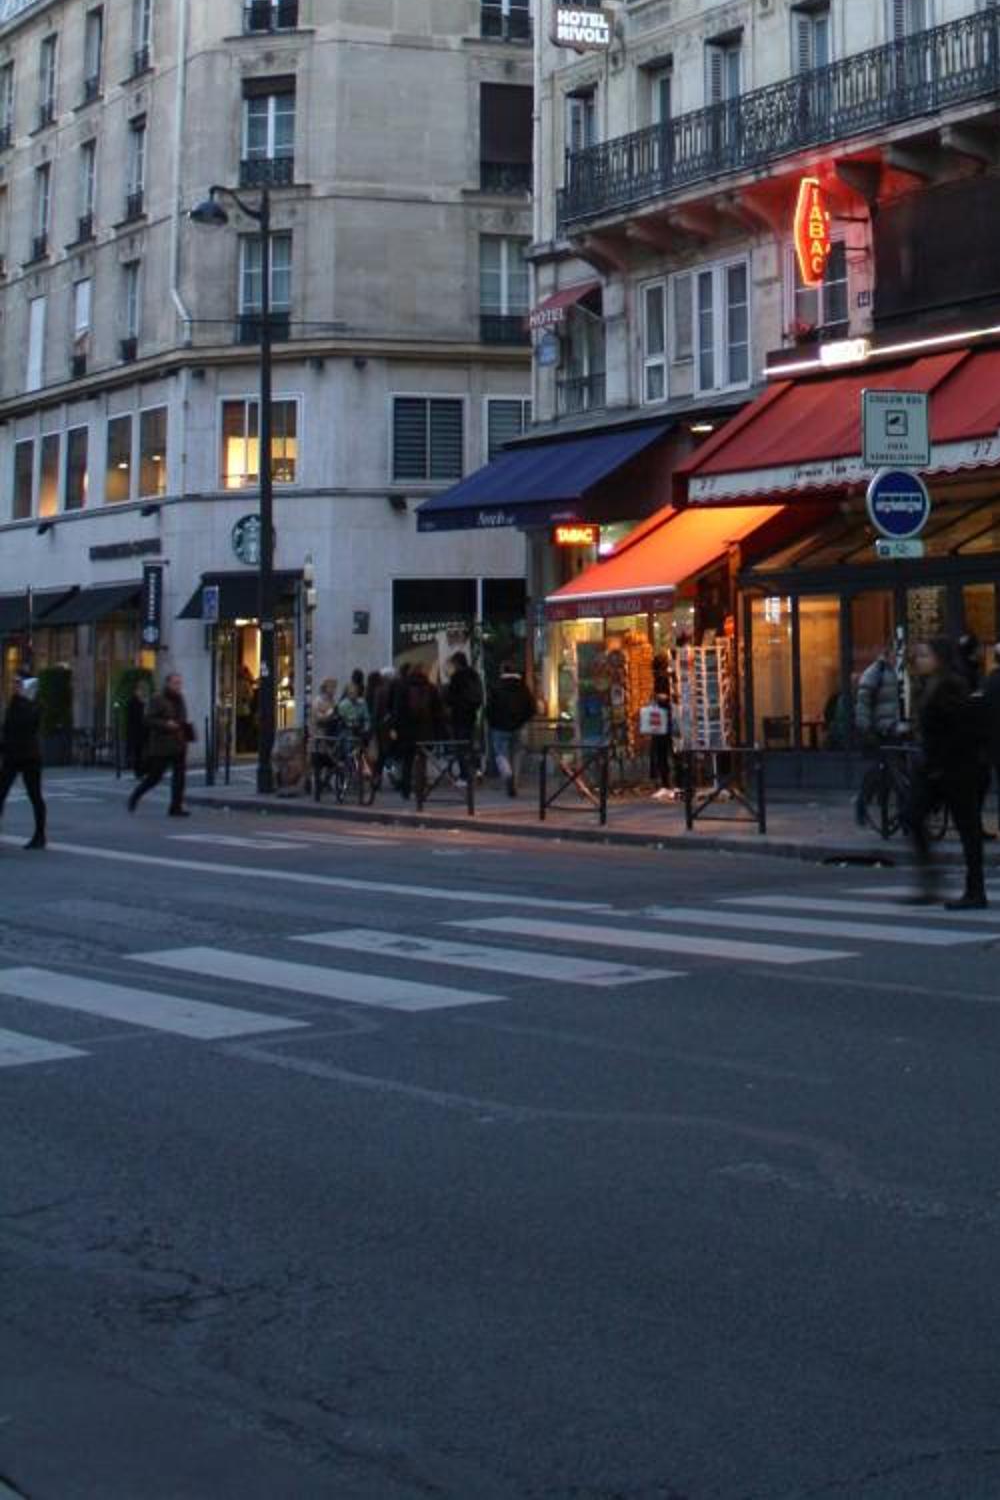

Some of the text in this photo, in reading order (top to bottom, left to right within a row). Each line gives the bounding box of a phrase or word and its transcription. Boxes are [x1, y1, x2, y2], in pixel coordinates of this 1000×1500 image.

[557, 9, 609, 28] HOTEL
[557, 25, 609, 44] RIVOLI
[808, 189, 825, 274] TABAC
[529, 308, 564, 326] HOTEL
[555, 526, 593, 545] TABAC
